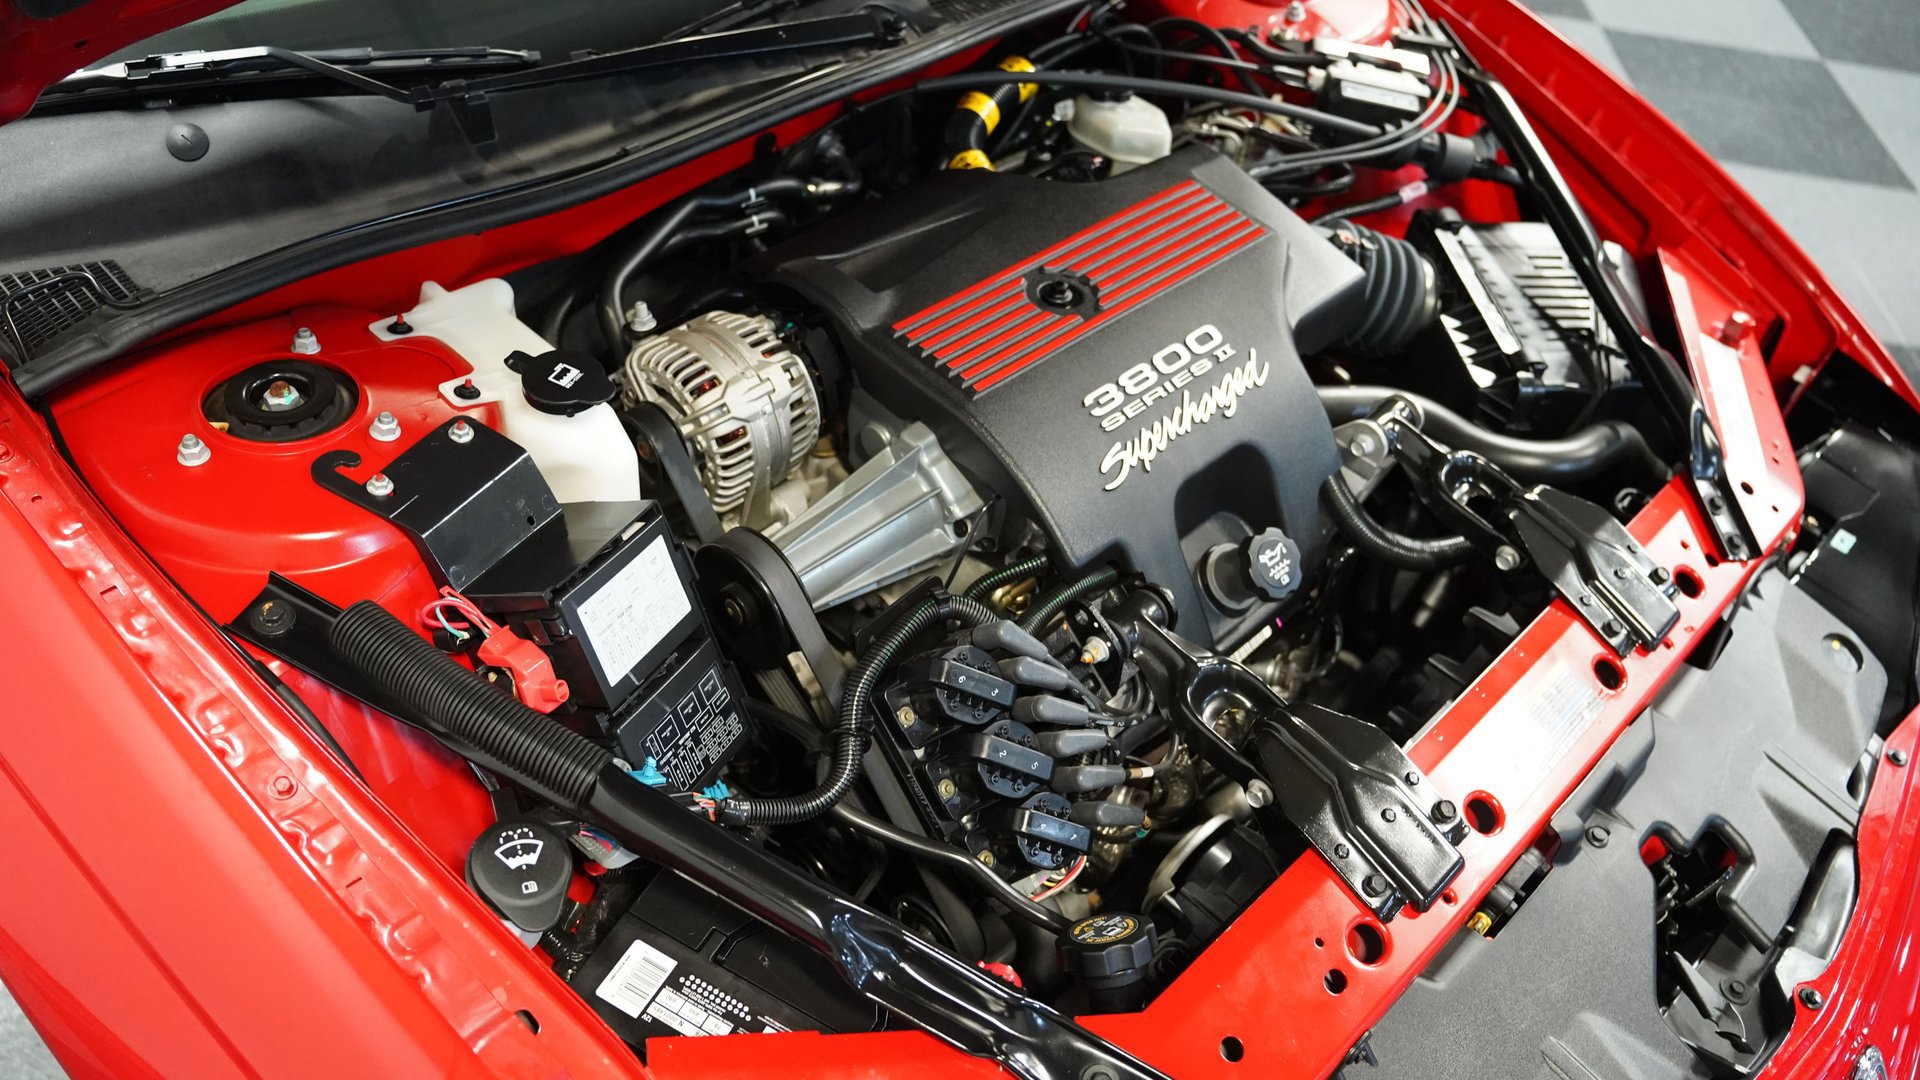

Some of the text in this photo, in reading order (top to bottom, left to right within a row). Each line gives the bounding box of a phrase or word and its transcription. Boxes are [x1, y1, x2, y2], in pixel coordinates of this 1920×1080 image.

[1083, 324, 1223, 417] 3800
[1100, 343, 1237, 432] SERIES II
[1100, 347, 1270, 491] Supercharged
[991, 688, 999, 697] 3
[999, 750, 1039, 770] 2 5
[641, 1013, 653, 1023] 12V
